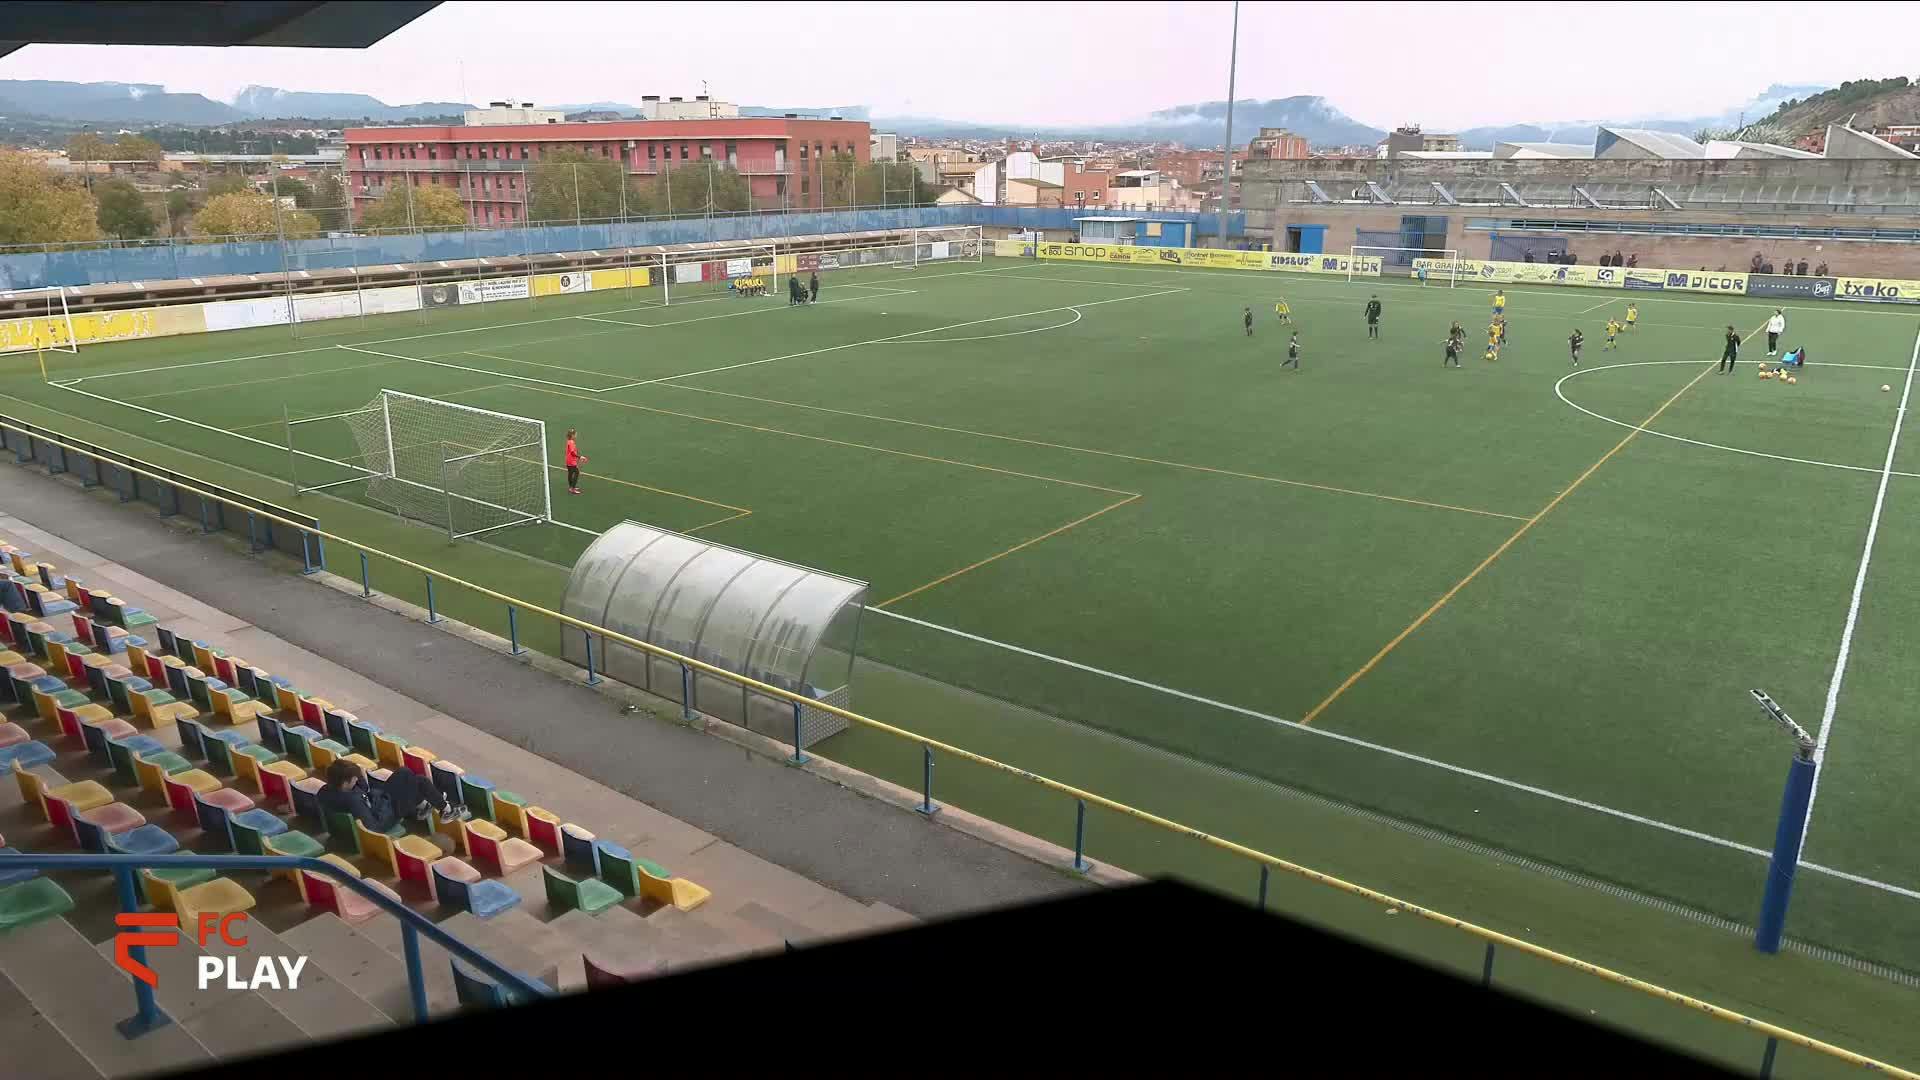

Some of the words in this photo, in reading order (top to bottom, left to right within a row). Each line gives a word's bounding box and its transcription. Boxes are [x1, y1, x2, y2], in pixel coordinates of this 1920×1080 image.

[1064, 246, 1106, 260] snop
[1271, 255, 1310, 265] KIDS&US
[1416, 260, 1432, 269] BAR
[1435, 261, 1475, 271] GRANADA
